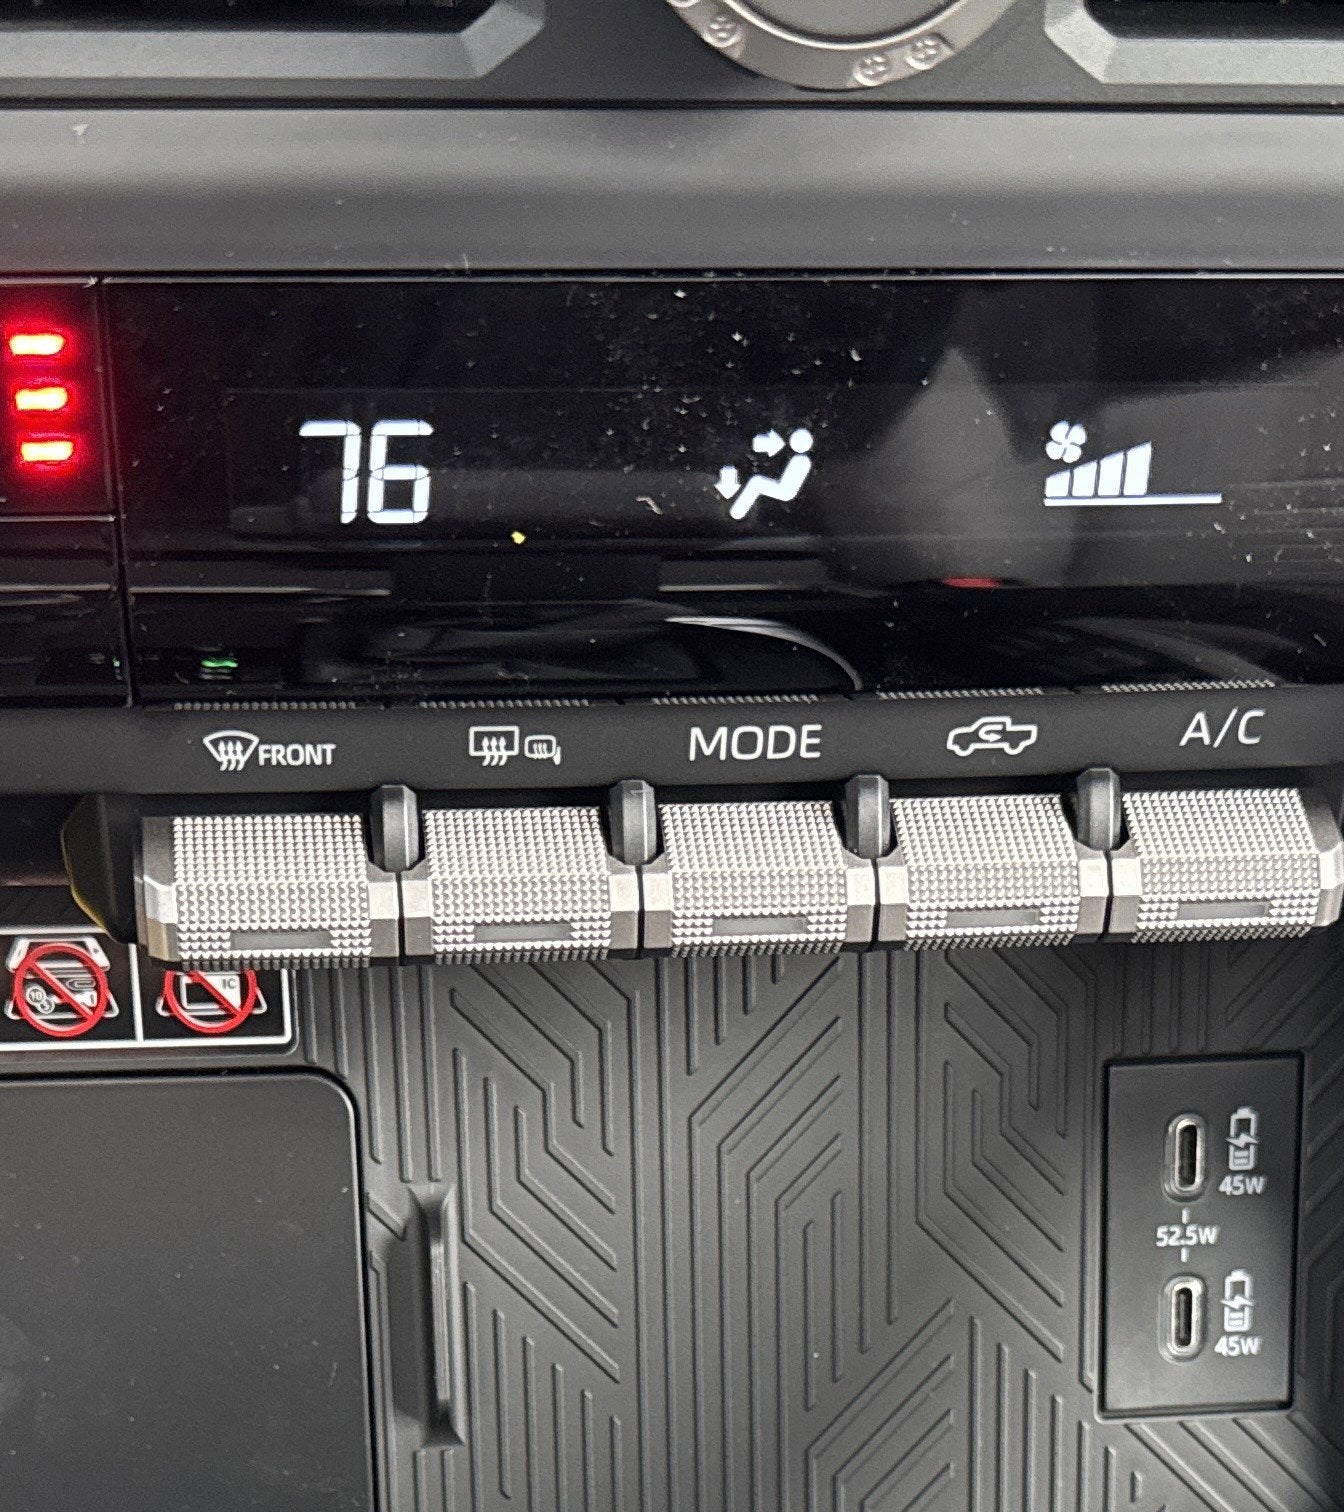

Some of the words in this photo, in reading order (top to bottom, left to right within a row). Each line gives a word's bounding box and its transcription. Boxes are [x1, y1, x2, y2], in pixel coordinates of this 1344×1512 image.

[299, 419, 434, 524] 76
[1179, 707, 1266, 748] A/C
[689, 723, 823, 762] MODE
[258, 743, 337, 766] FRONT
[1218, 1175, 1268, 1196] 45W
[1156, 1225, 1219, 1247] 52.5W
[1213, 1336, 1262, 1356] 45W
